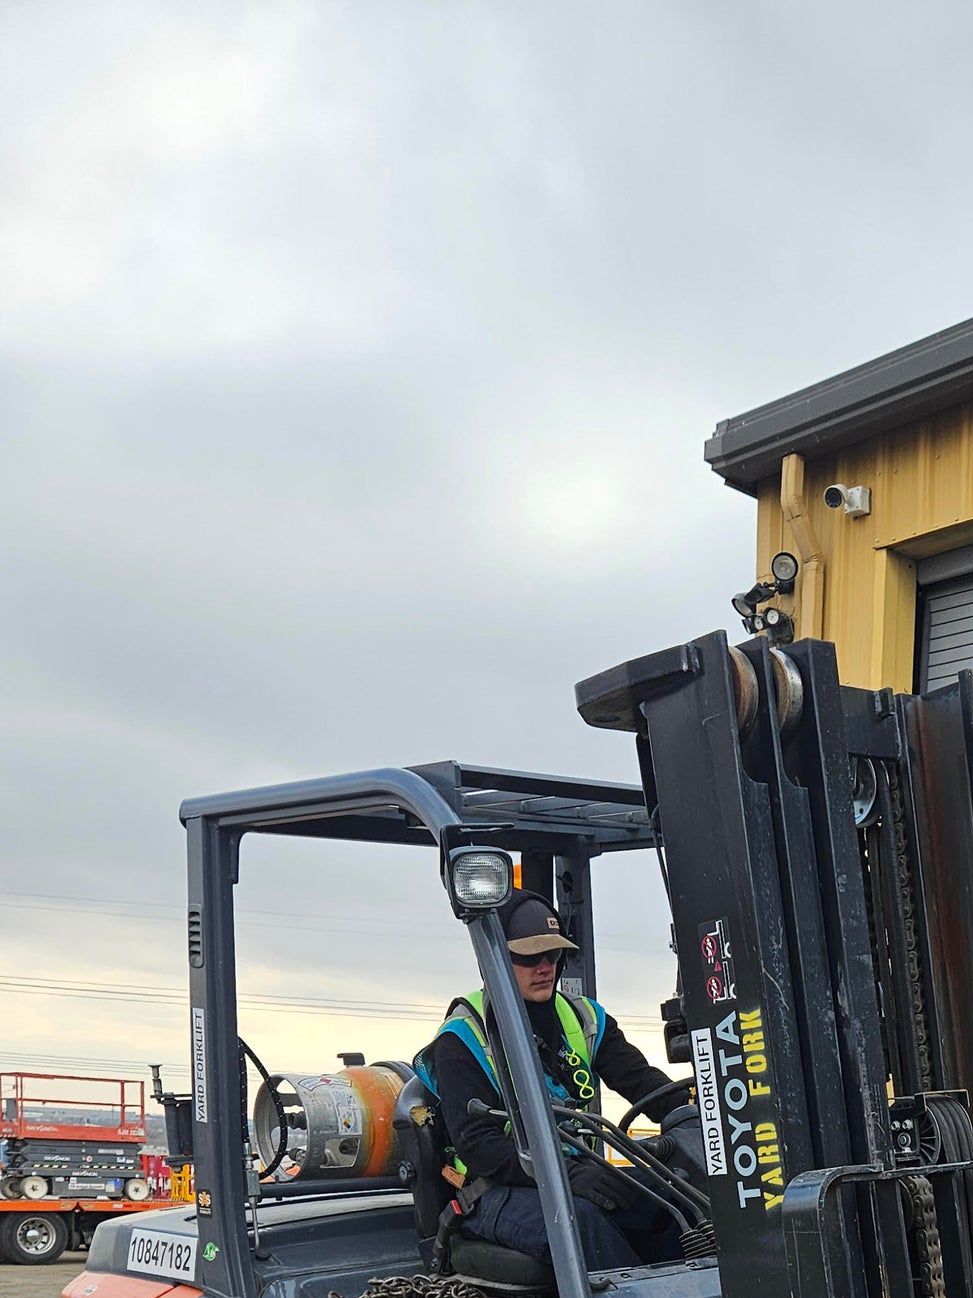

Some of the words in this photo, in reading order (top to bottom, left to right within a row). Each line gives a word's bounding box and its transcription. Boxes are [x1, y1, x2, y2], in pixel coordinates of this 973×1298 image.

[196, 1012, 204, 1080] FORKLIFT
[696, 1036, 717, 1122] FORKLIFT
[739, 1009, 771, 1097] FORK
[708, 1126, 722, 1174] YARD
[715, 1010, 761, 1209] TOYOTA
[755, 1122, 784, 1210] YARD
[131, 1237, 191, 1271] 10847182
